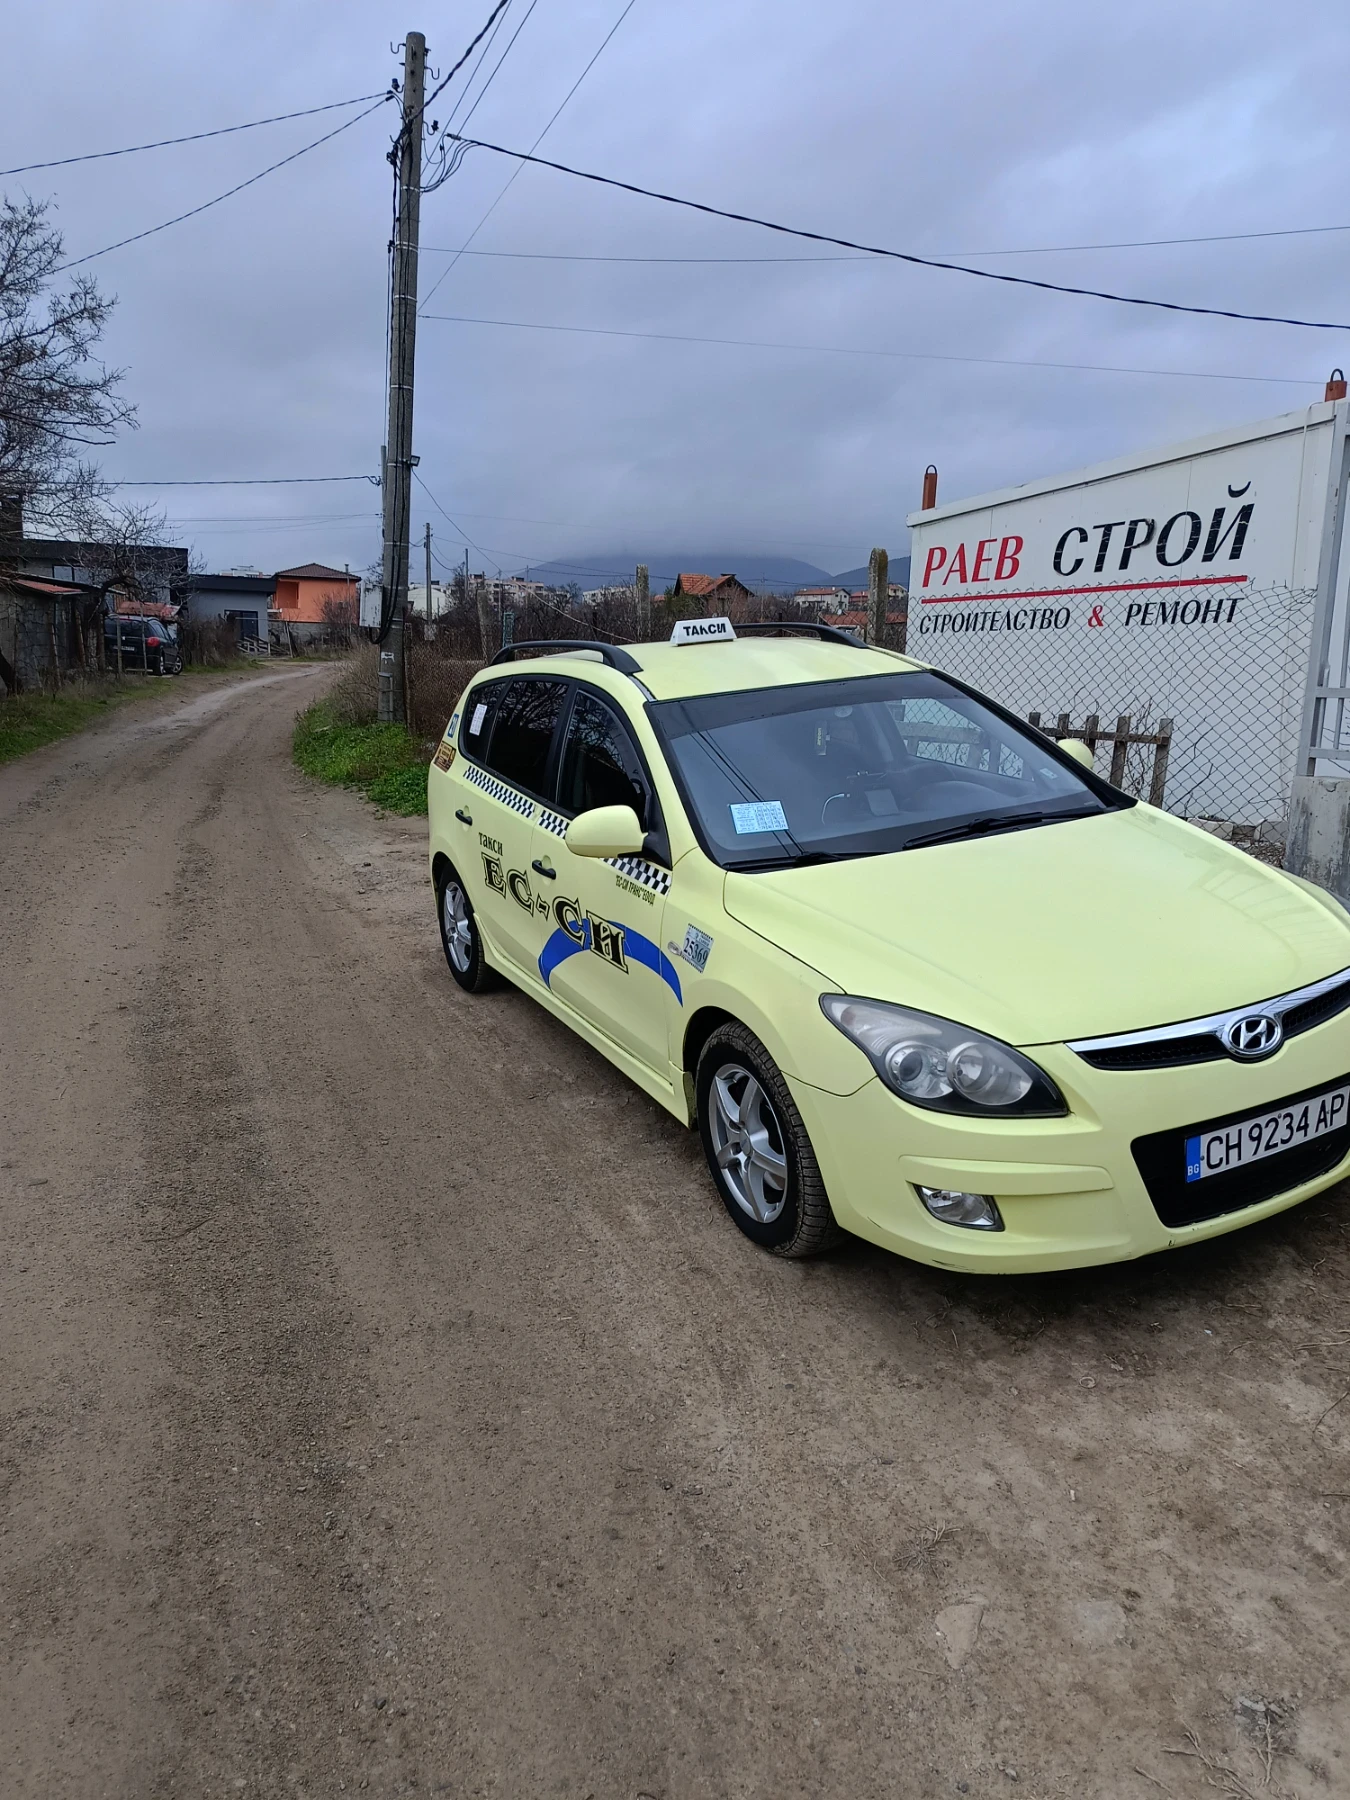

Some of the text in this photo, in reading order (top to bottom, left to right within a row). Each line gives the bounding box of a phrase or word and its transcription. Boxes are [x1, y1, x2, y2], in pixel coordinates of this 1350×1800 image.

[921, 480, 1255, 588] РАЕВ СТРОЙ
[682, 623, 727, 637] ТАКСИ
[919, 598, 1245, 635] СТРОИТЕЛСТВО & РЕМОНТ
[683, 937, 709, 966] 25369
[1206, 1093, 1346, 1170] CH 9234 AP
[1187, 1163, 1200, 1177] BG
